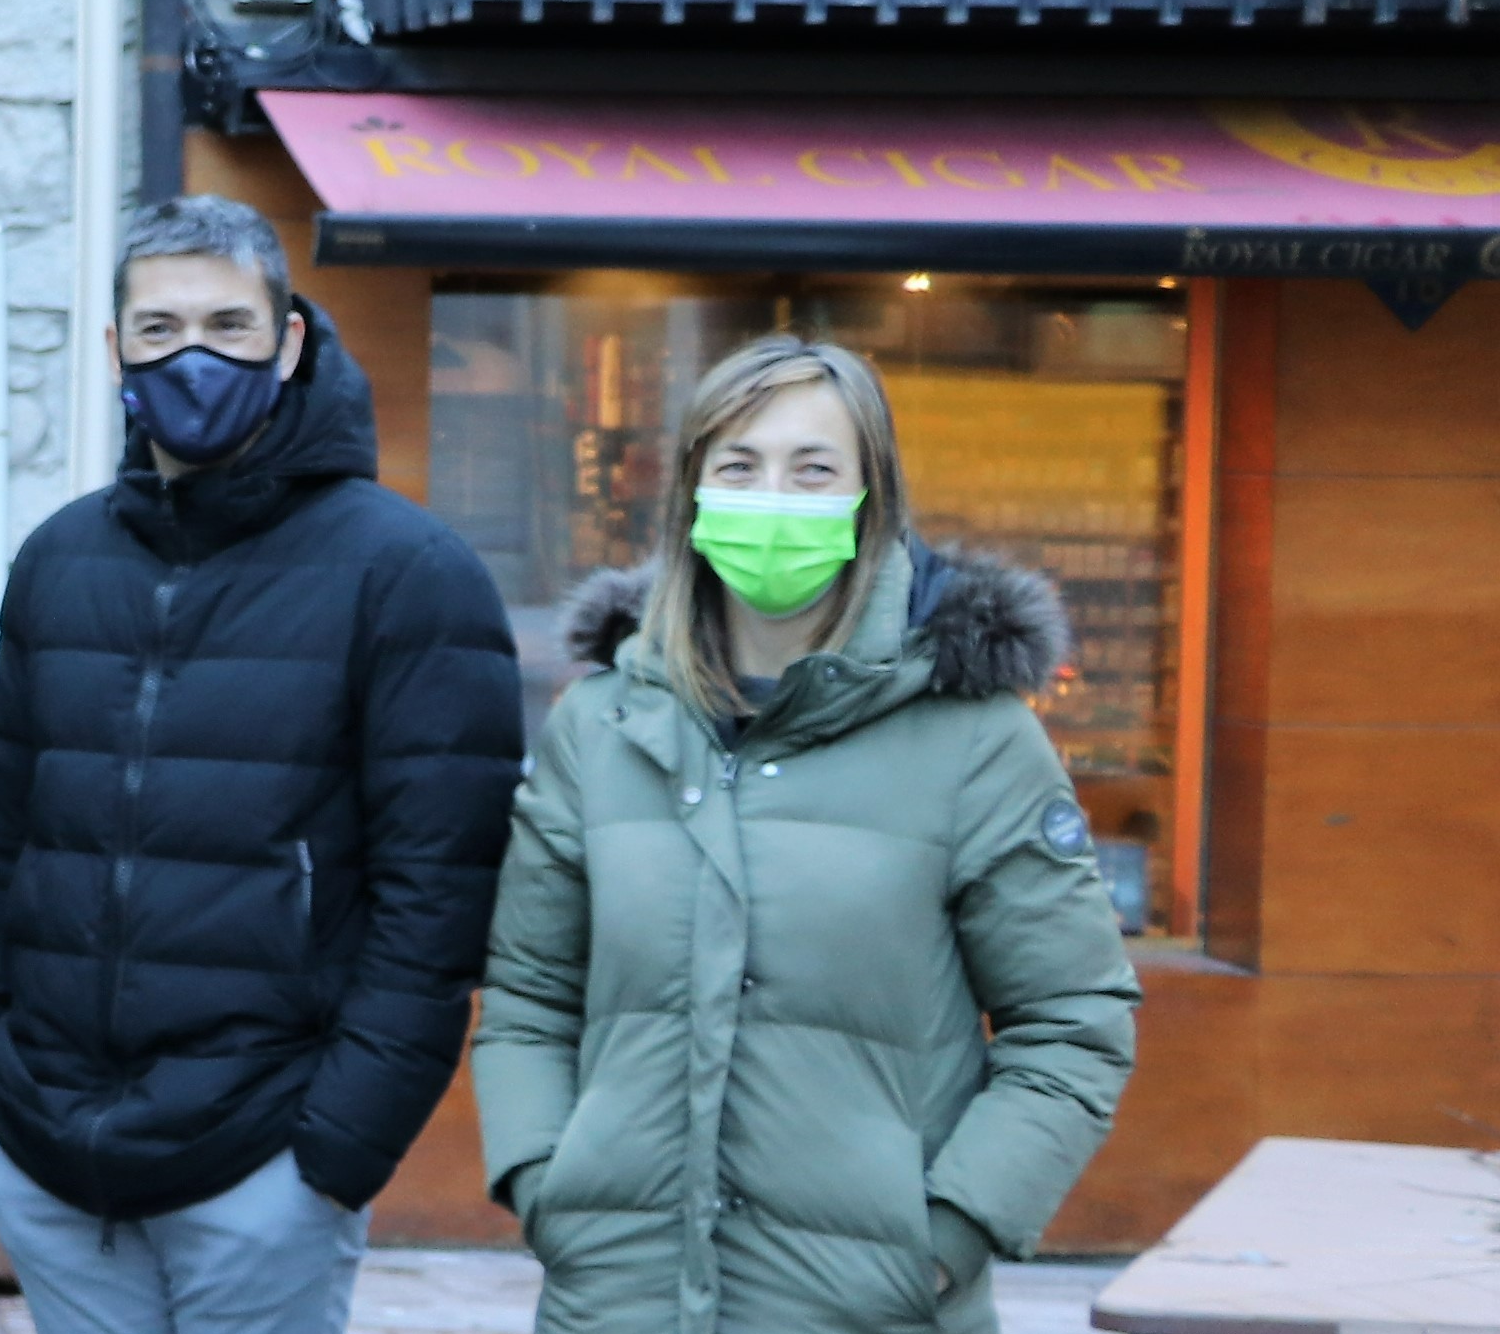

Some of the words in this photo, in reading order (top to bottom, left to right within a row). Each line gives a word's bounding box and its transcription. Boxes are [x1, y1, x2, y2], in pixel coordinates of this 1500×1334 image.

[360, 133, 778, 186] ROYAL
[796, 146, 1210, 193] CIGAR
[1182, 237, 1302, 269] ROYAL
[1318, 240, 1452, 269] CIGAR
